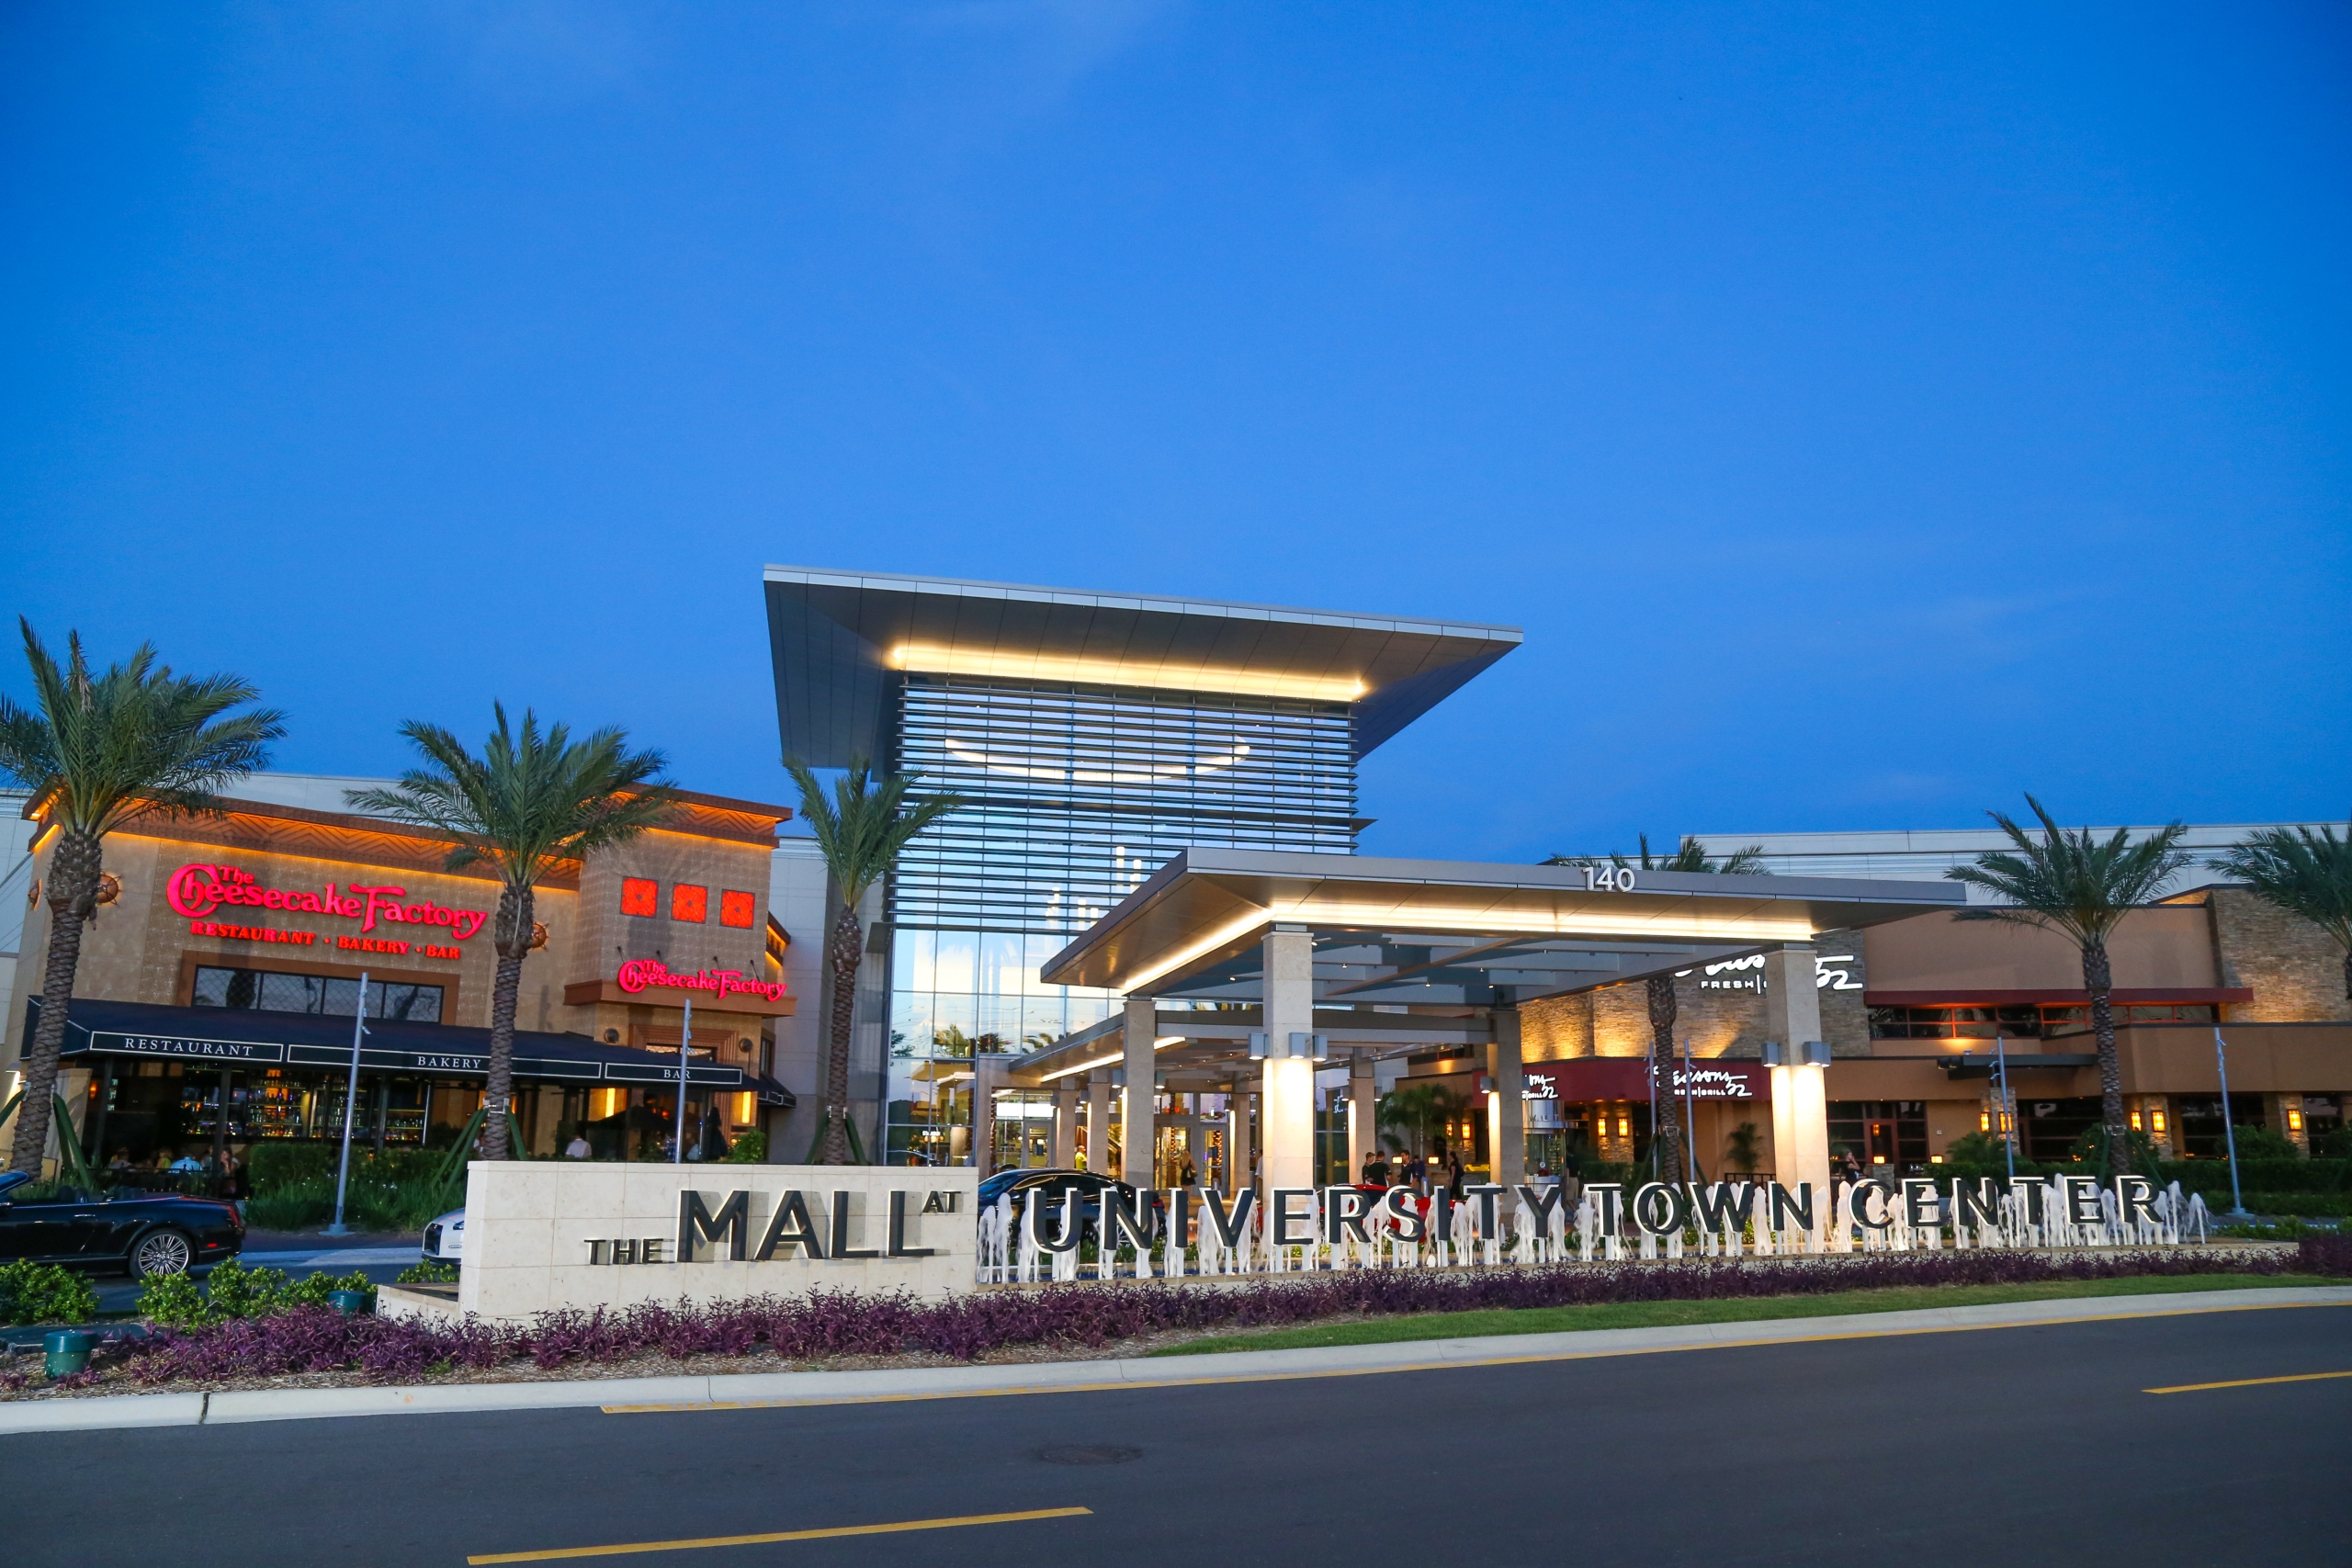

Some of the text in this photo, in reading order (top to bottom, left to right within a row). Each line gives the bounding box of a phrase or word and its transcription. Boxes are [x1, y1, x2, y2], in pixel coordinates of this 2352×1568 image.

[219, 865, 255, 886] The
[1582, 866, 1635, 892] 140
[166, 863, 488, 940] Cheesecake Factory
[190, 920, 460, 960] RESTAURANT BAKERY BAR
[644, 959, 667, 974] The
[618, 960, 786, 1001] Cheesecake Factory
[124, 1037, 254, 1057] RESTAURANT
[417, 1055, 481, 1069] BAKERY
[663, 1068, 691, 1079] BAR
[583, 1190, 962, 1265] THE MALL AT
[1027, 1175, 2166, 1254] UNIVERSITY TOWN CENTER
